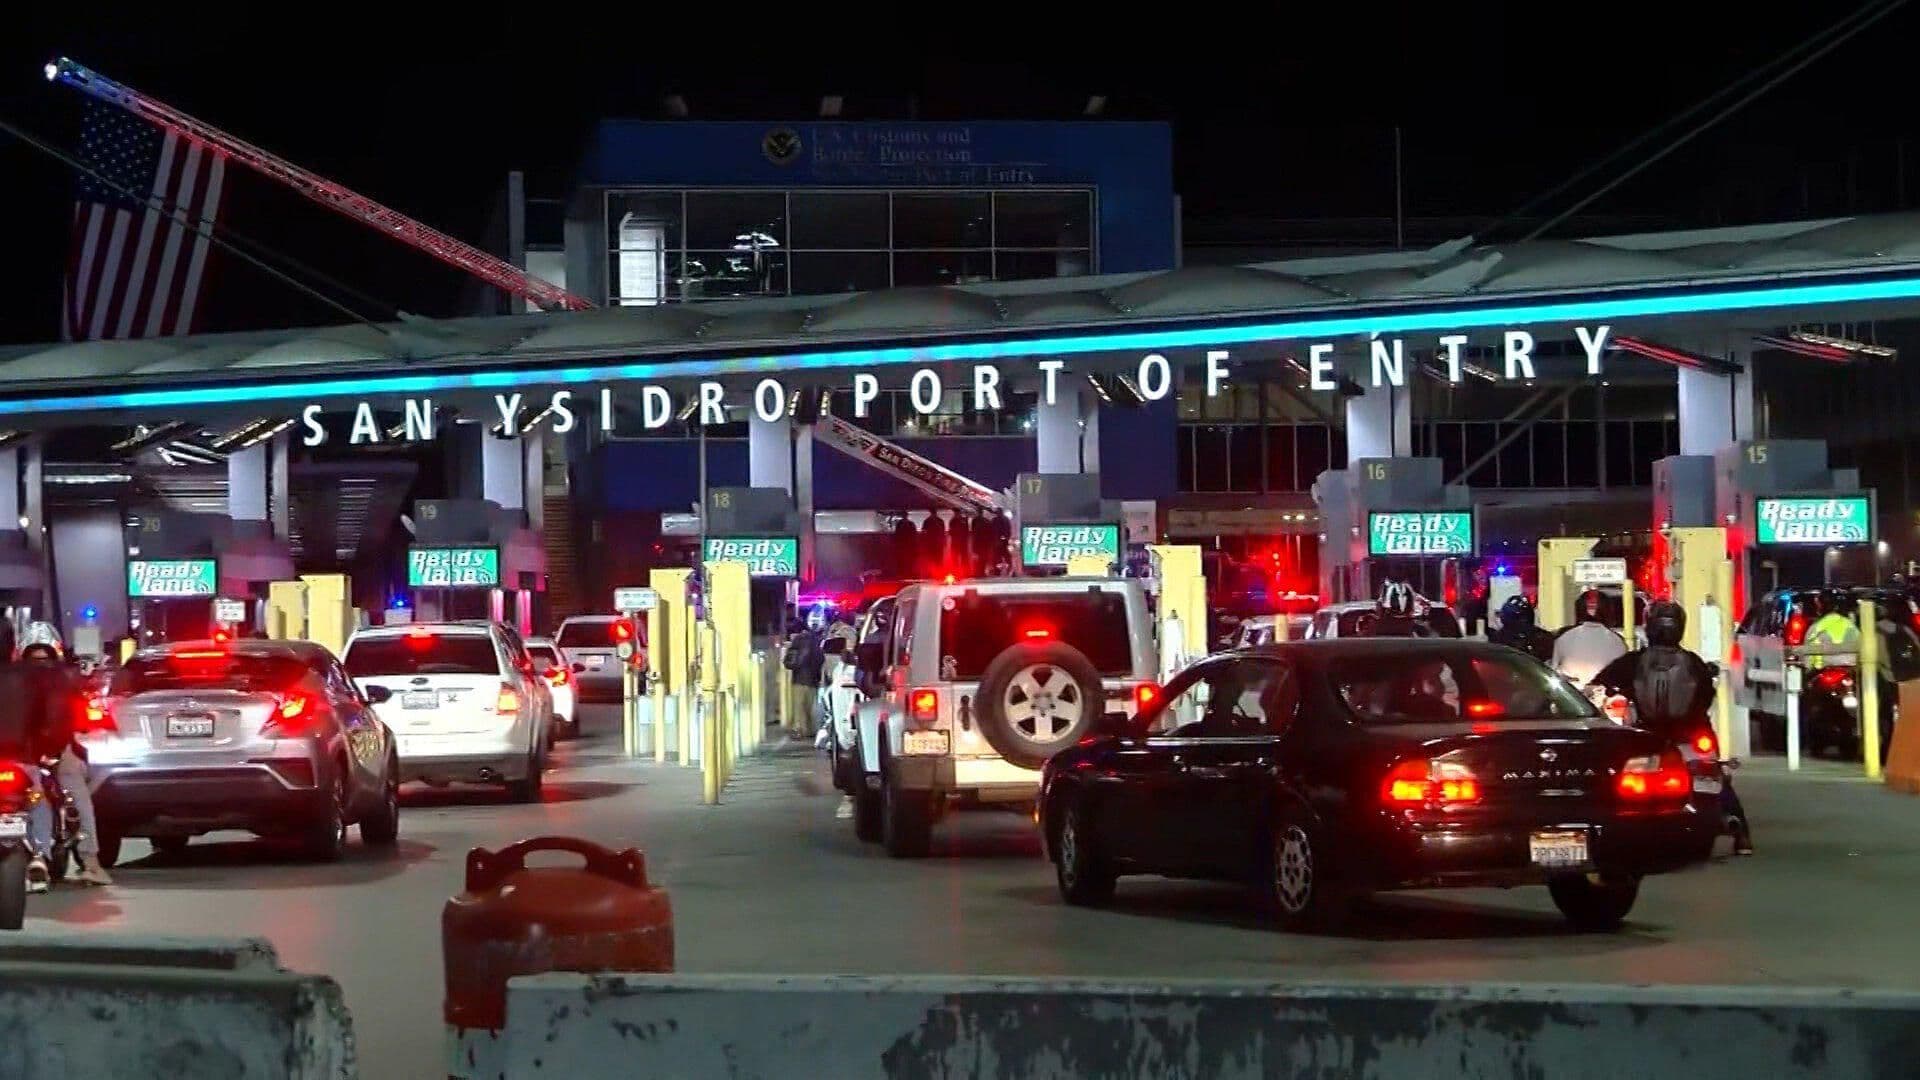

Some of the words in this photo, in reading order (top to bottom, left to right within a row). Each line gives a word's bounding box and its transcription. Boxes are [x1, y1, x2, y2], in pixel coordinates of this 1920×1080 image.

[302, 398, 433, 446] SAN
[494, 379, 786, 437] YSIDRO
[854, 360, 1065, 418] PORT
[1137, 351, 1231, 401] OF
[1310, 325, 1611, 391] ENTRY
[1747, 445, 1768, 464] 15
[1367, 463, 1386, 480] 16
[713, 492, 731, 509] 18
[1761, 499, 1856, 521] Ready
[420, 504, 437, 520] 19
[1374, 513, 1459, 534] Ready
[1025, 526, 1106, 546] Ready
[708, 539, 786, 558] Ready
[413, 550, 486, 569] Ready
[132, 561, 203, 580] Ready
[1502, 768, 1597, 781] MAXIMA
